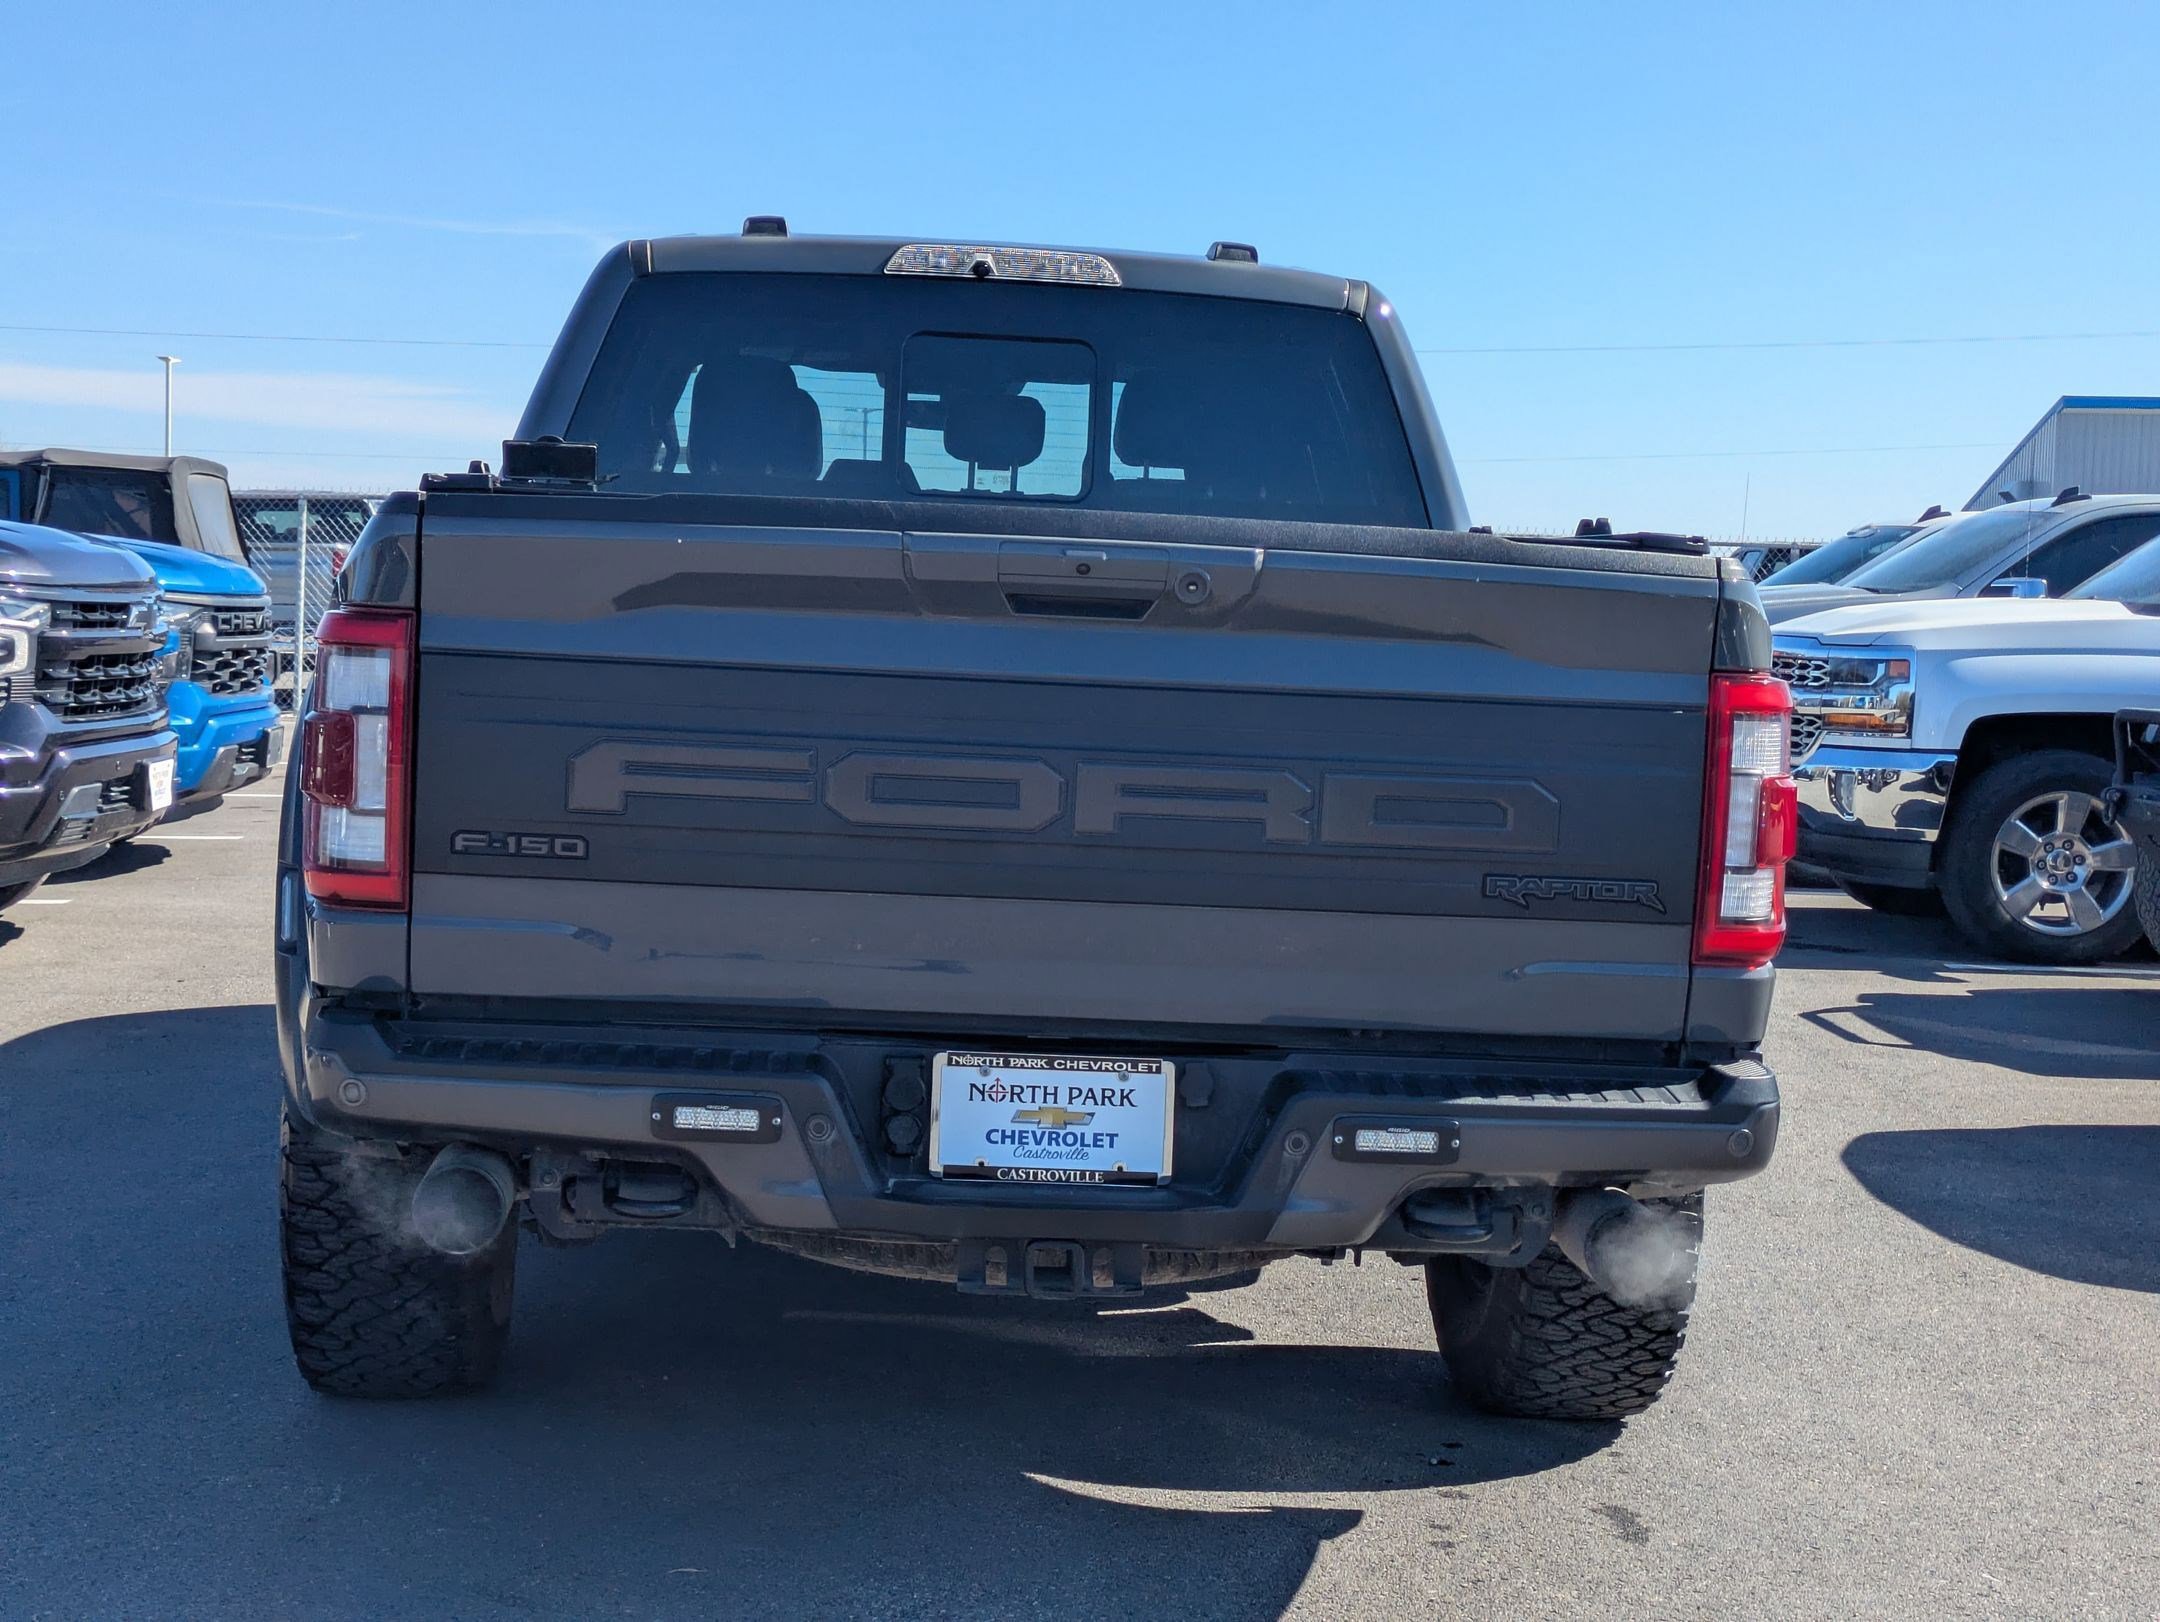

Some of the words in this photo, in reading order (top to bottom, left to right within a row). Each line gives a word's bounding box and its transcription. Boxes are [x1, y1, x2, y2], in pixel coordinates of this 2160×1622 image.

[565, 736, 1561, 855] FORD
[453, 831, 586, 858] F-150
[1485, 875, 1667, 914] RAPTOR
[951, 1054, 1004, 1067] NORTH
[1008, 1058, 1050, 1069] PARK
[1053, 1059, 1160, 1073] CHEVROLET
[968, 1078, 1059, 1105] NORTH
[1067, 1086, 1138, 1108] PARK
[985, 1128, 1119, 1149] CHEVROLET
[1013, 1145, 1090, 1161] Castroville
[996, 1168, 1105, 1183] CASTROVILLE
